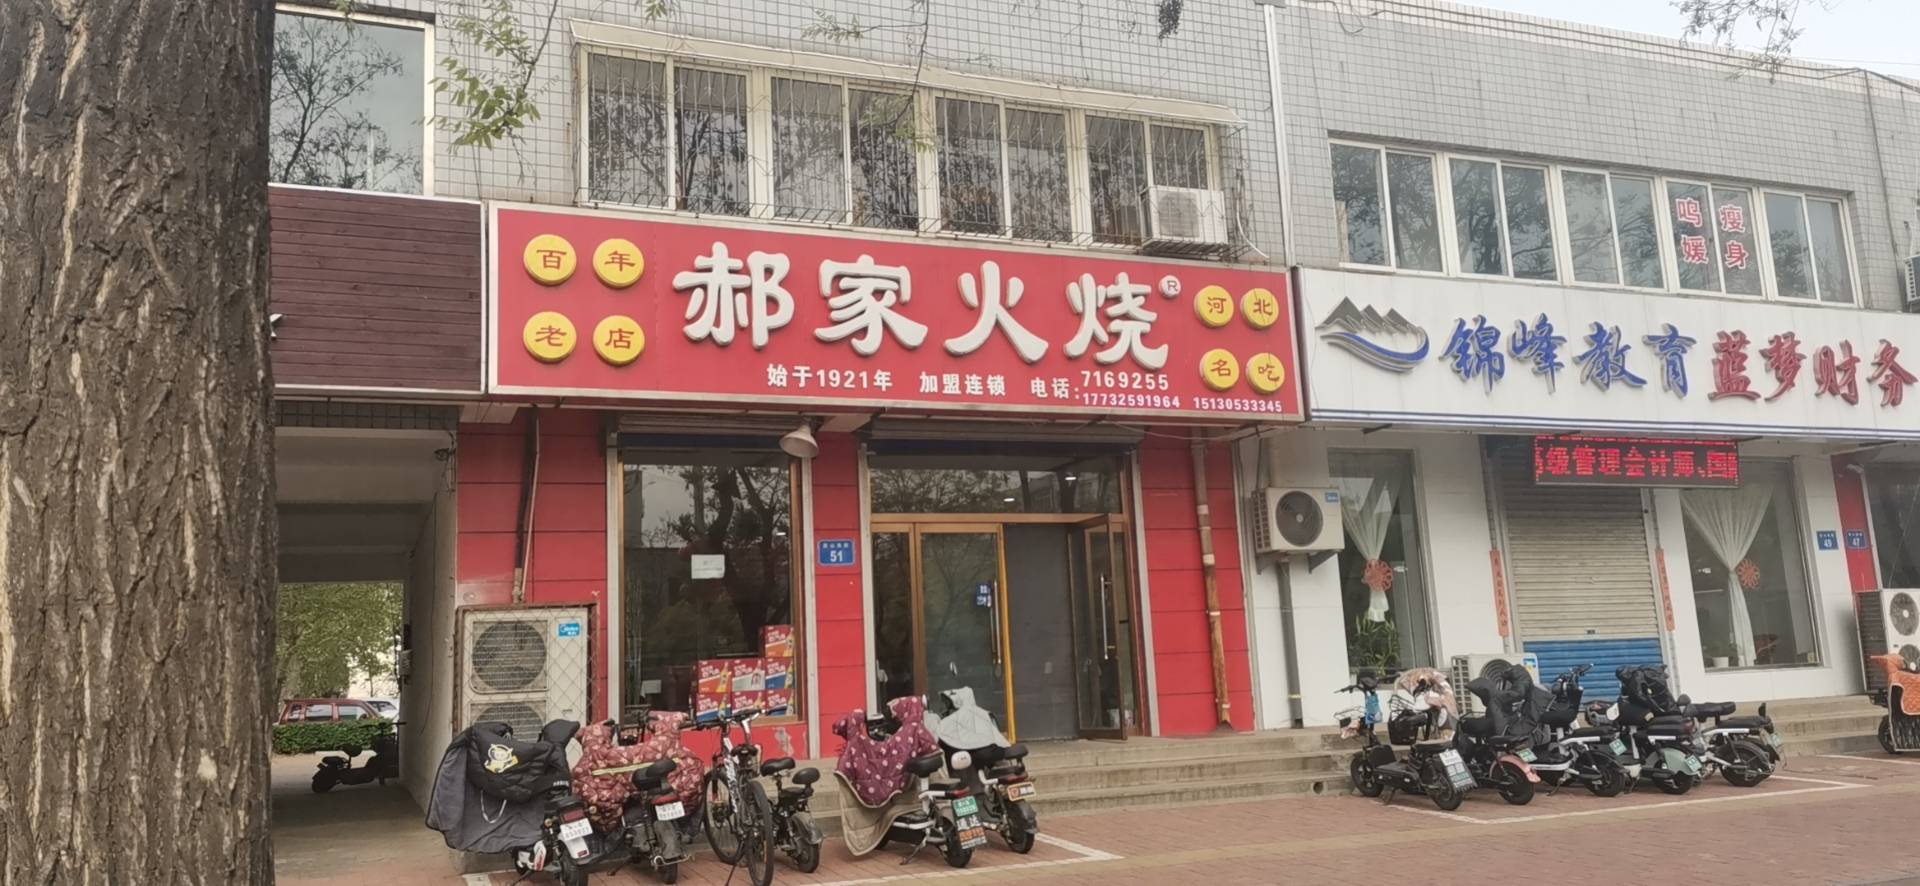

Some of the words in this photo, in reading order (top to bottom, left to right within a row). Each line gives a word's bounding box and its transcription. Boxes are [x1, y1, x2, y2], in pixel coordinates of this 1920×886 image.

[1719, 204, 1749, 269] 瘦身
[536, 248, 636, 272] 百年
[672, 241, 1169, 370] 郝家火烧
[1206, 296, 1274, 316] 河北
[535, 325, 635, 350] 老店
[1211, 359, 1280, 383] 名吃
[1439, 313, 1698, 397] 锦峰教育
[1708, 330, 1918, 406] 蓝梦财务
[767, 364, 893, 391] 始于1921年
[919, 371, 1006, 397] 加盟连锁
[1081, 370, 1169, 391] 7169255
[1083, 391, 1180, 408] 17732591964
[1193, 396, 1283, 413] 15130533345
[830, 550, 843, 562] 51
